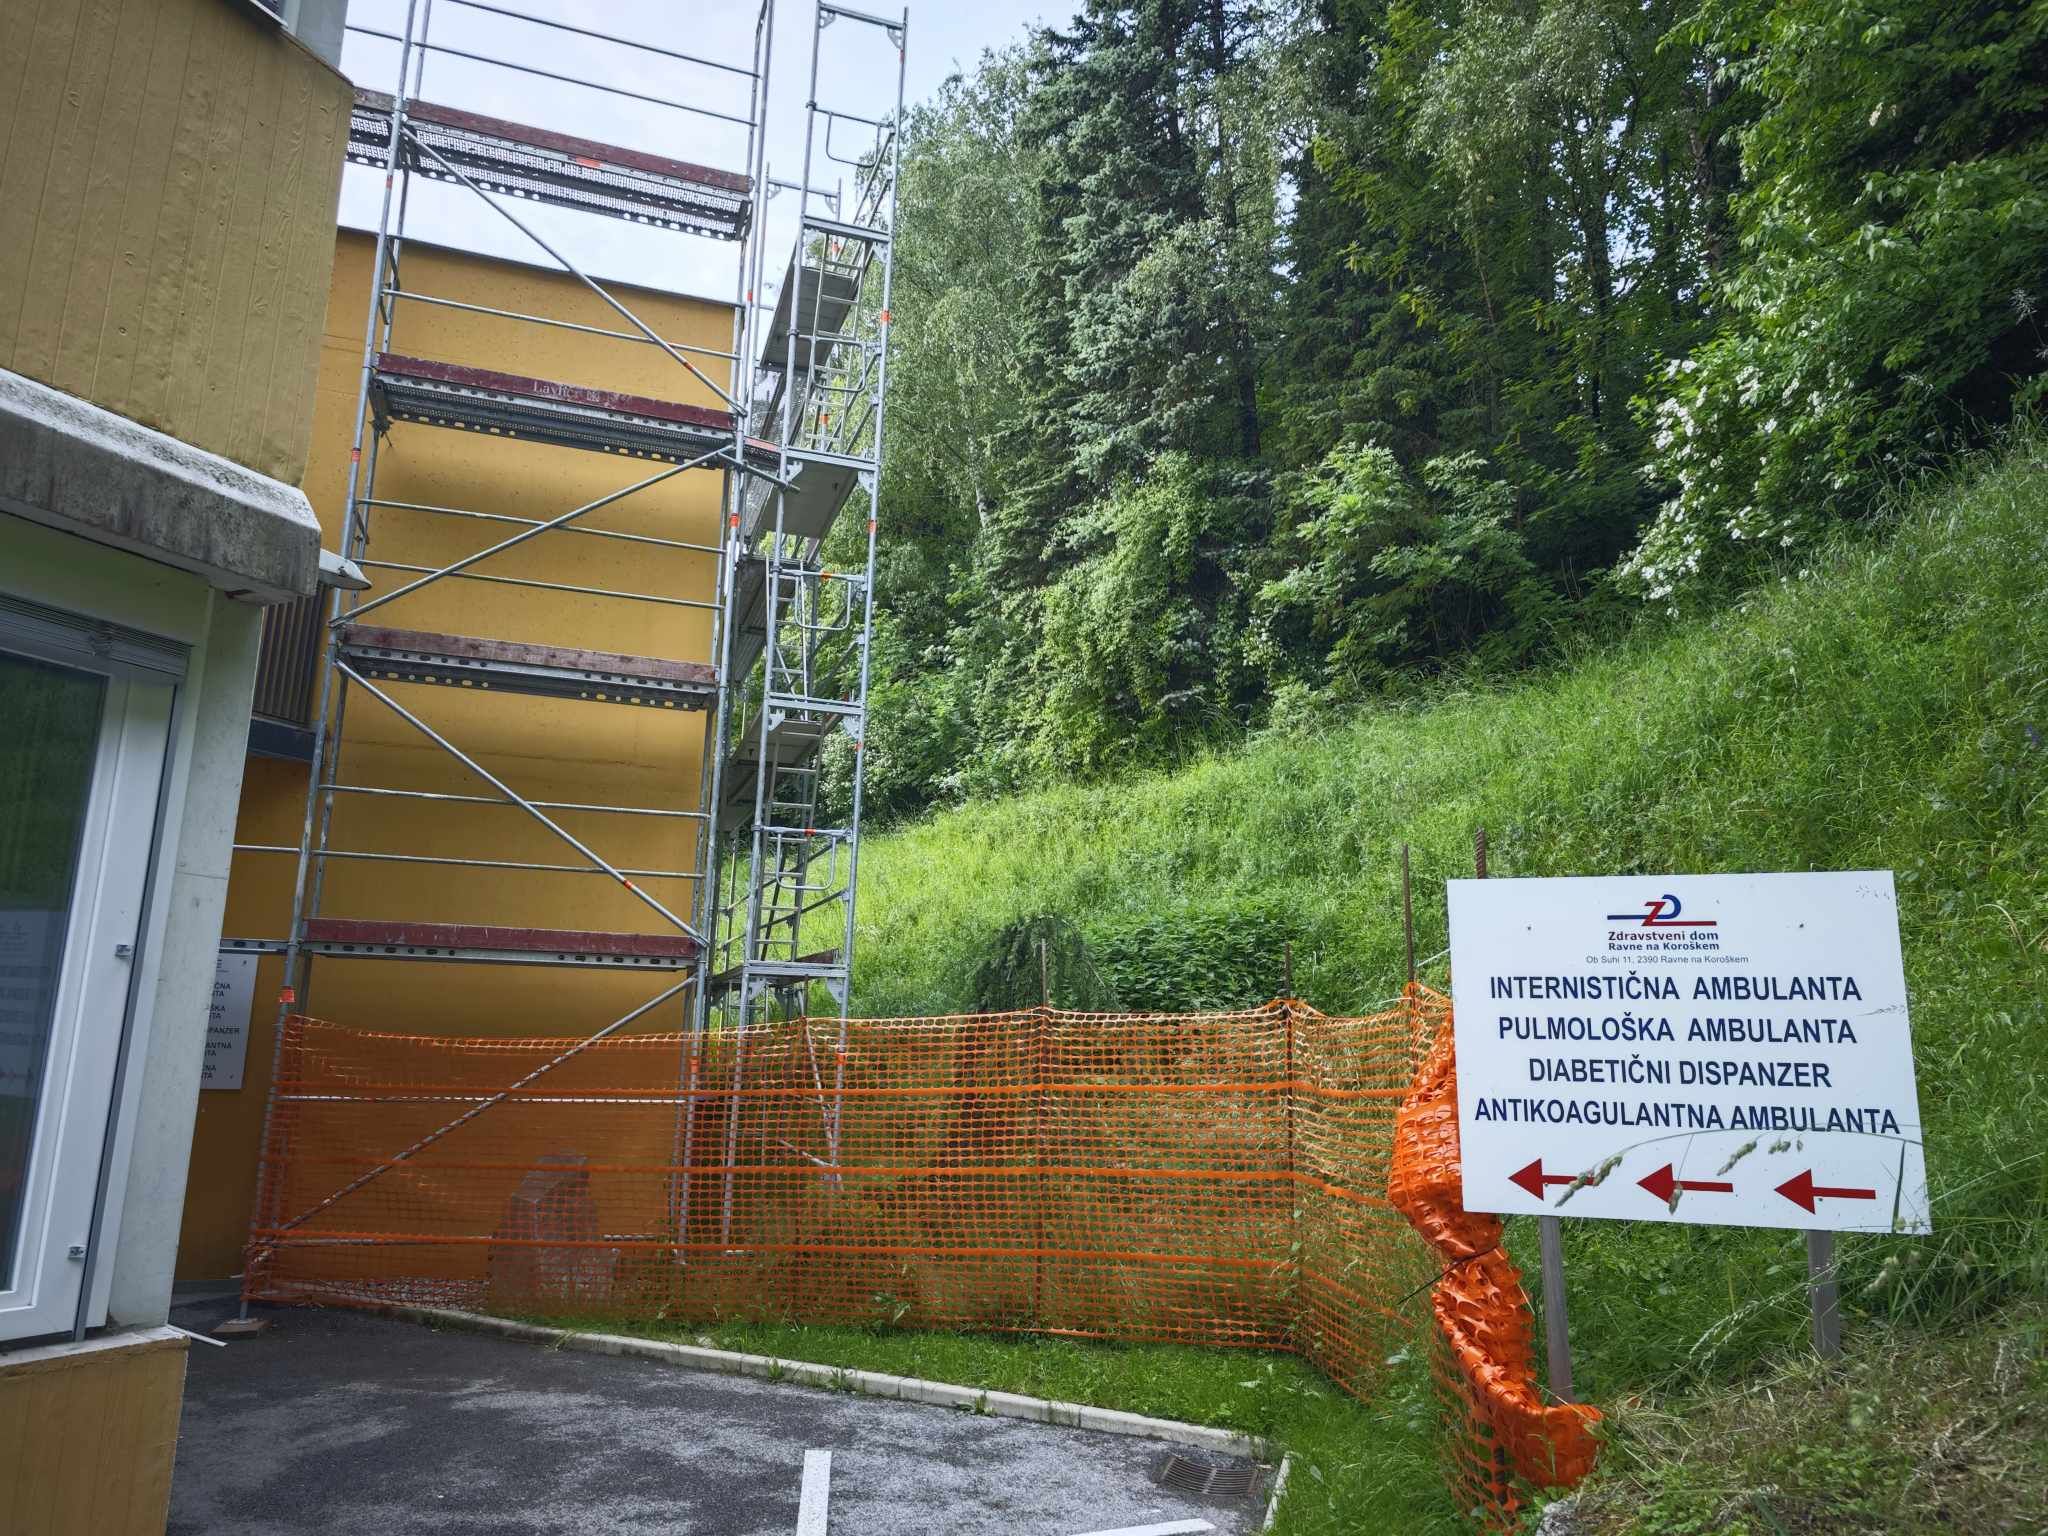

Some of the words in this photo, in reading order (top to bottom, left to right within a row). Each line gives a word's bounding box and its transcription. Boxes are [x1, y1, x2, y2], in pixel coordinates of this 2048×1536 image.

[1608, 931, 1686, 941] Zdravstveni
[1689, 931, 1719, 941] dom
[1608, 942, 1643, 951] Ravne
[1646, 943, 1660, 951] na
[1663, 941, 1720, 951] Koroškem
[1586, 956, 1599, 964] Ob
[1637, 956, 1659, 964] 2390
[1704, 955, 1749, 964] Koroškem
[1490, 971, 1680, 1001] INTERNISTIČNA
[1693, 976, 1862, 1001] AMBULANTA
[1499, 1012, 1675, 1042] PULMOLOŠKA
[1687, 1018, 1858, 1044] AMBULANTA
[1529, 1054, 1671, 1085] DIABETIČNI
[1679, 1060, 1832, 1088] DISPANZER
[1474, 1098, 1724, 1130] ANTIKOAGULANTNA
[1730, 1104, 1901, 1135] AMBULANTA
